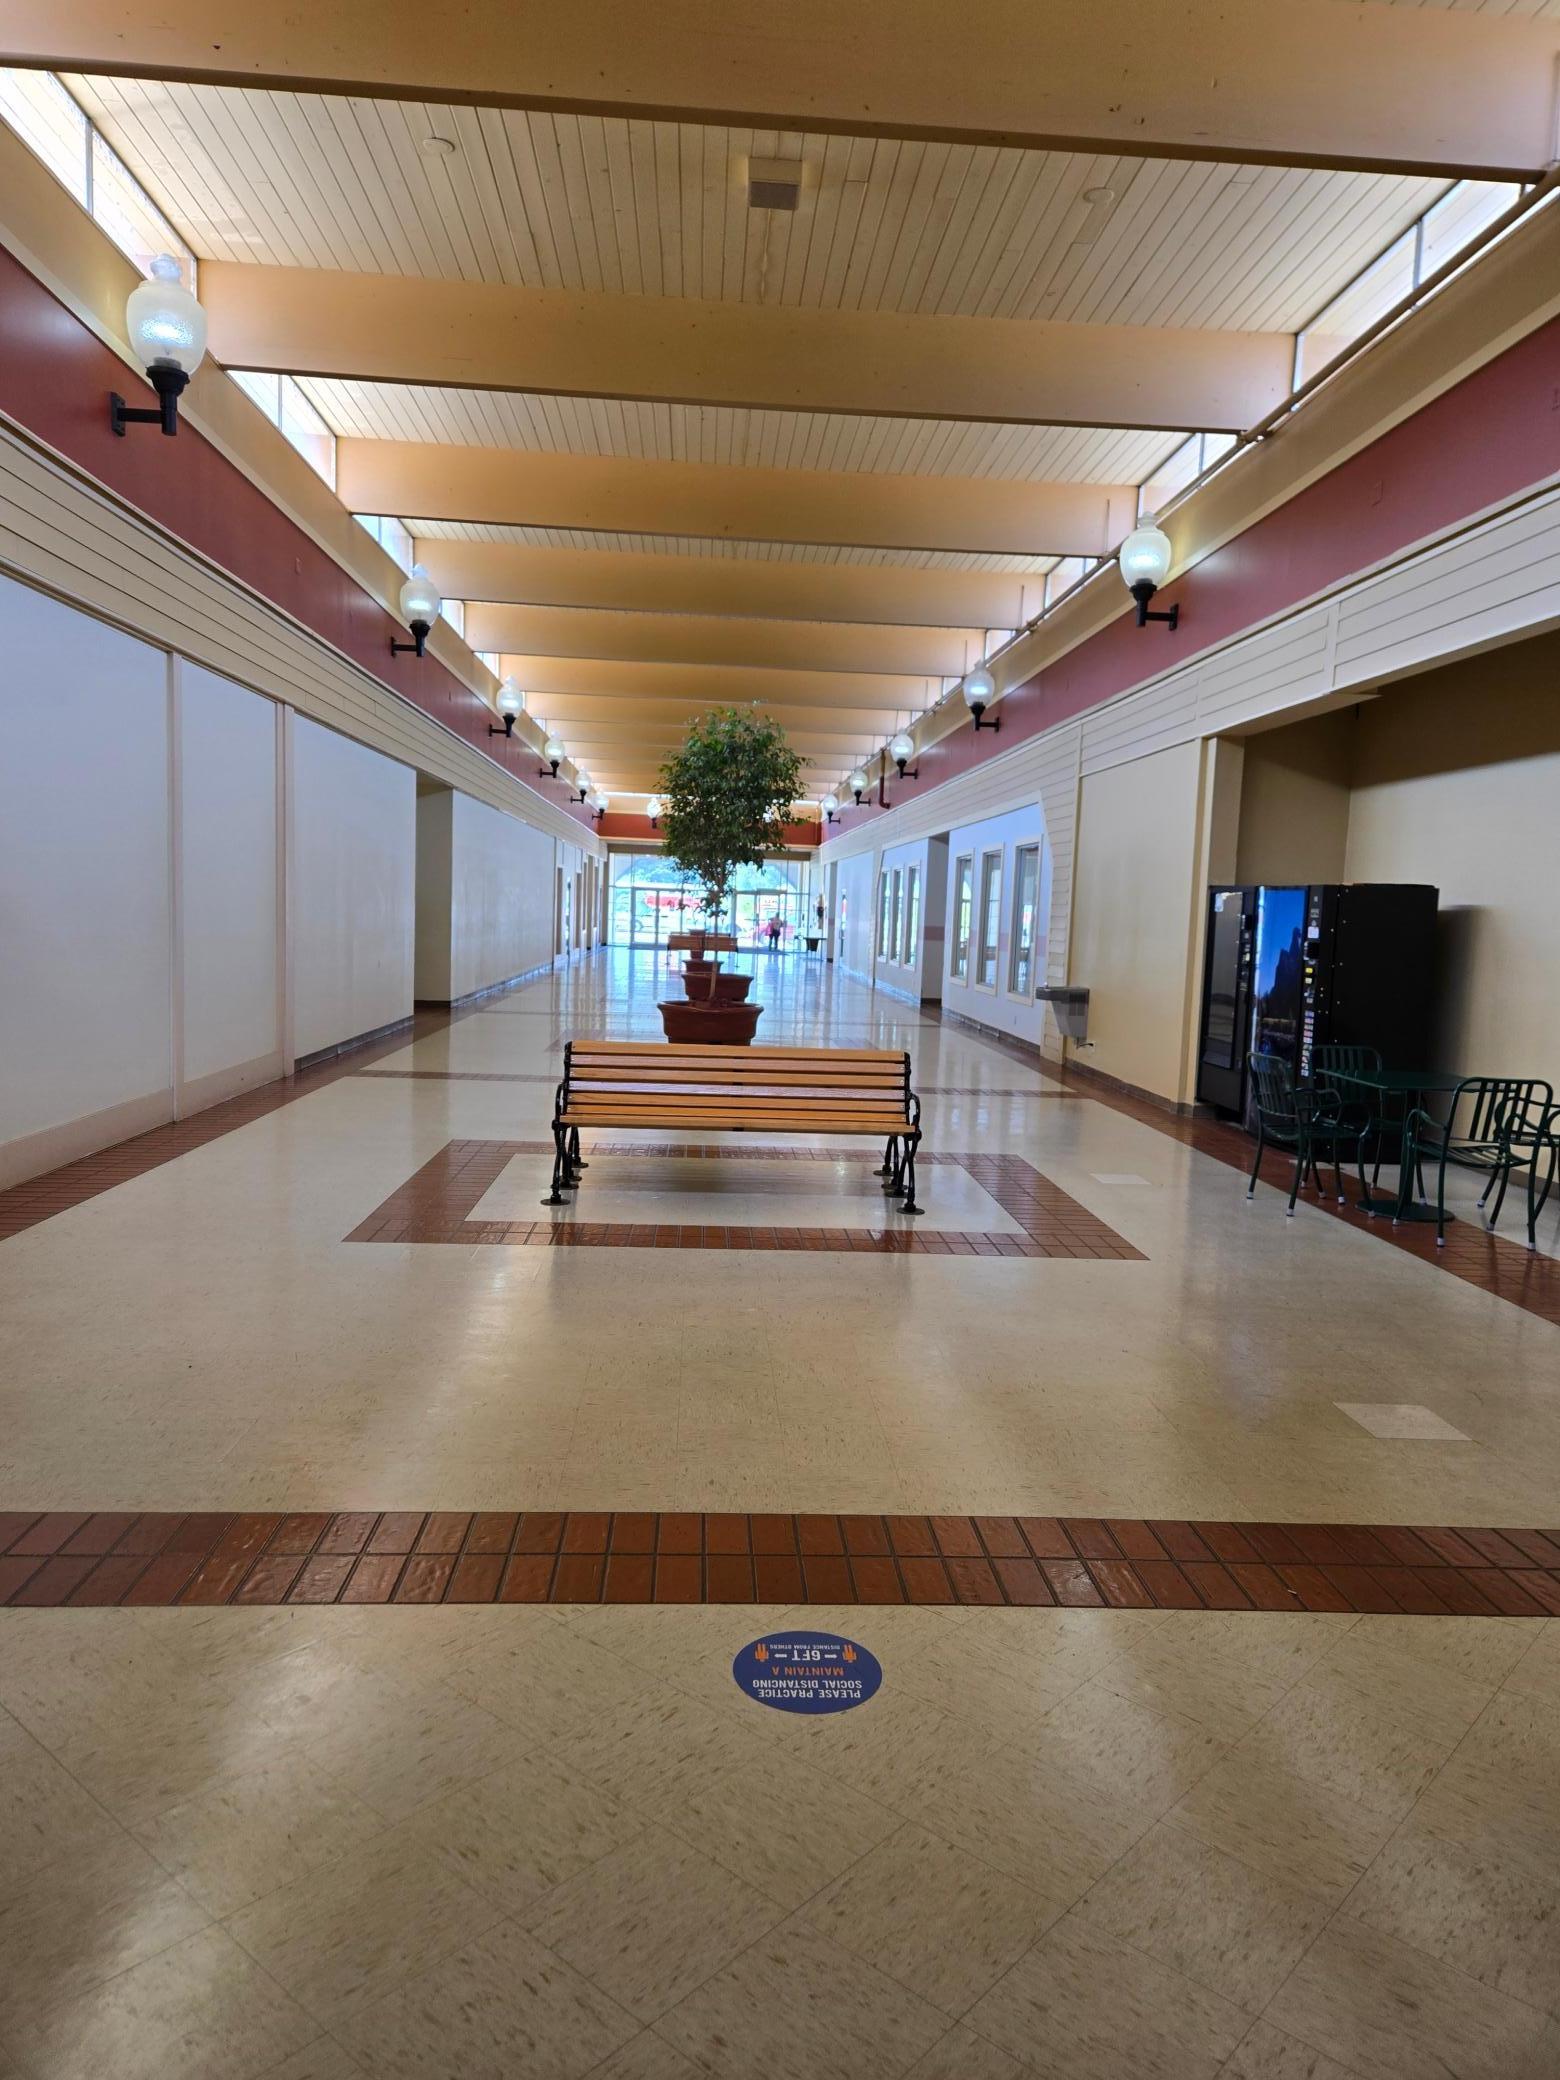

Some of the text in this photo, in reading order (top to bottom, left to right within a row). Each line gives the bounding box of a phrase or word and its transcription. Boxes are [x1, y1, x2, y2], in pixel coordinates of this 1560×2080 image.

[791, 1650, 821, 1661] 6FT
[771, 1666, 844, 1676] MAINTAIN A
[752, 1679, 862, 1688] SOCIAL DISTANCING
[758, 1689, 861, 1698] PLEASE PRACTICE
